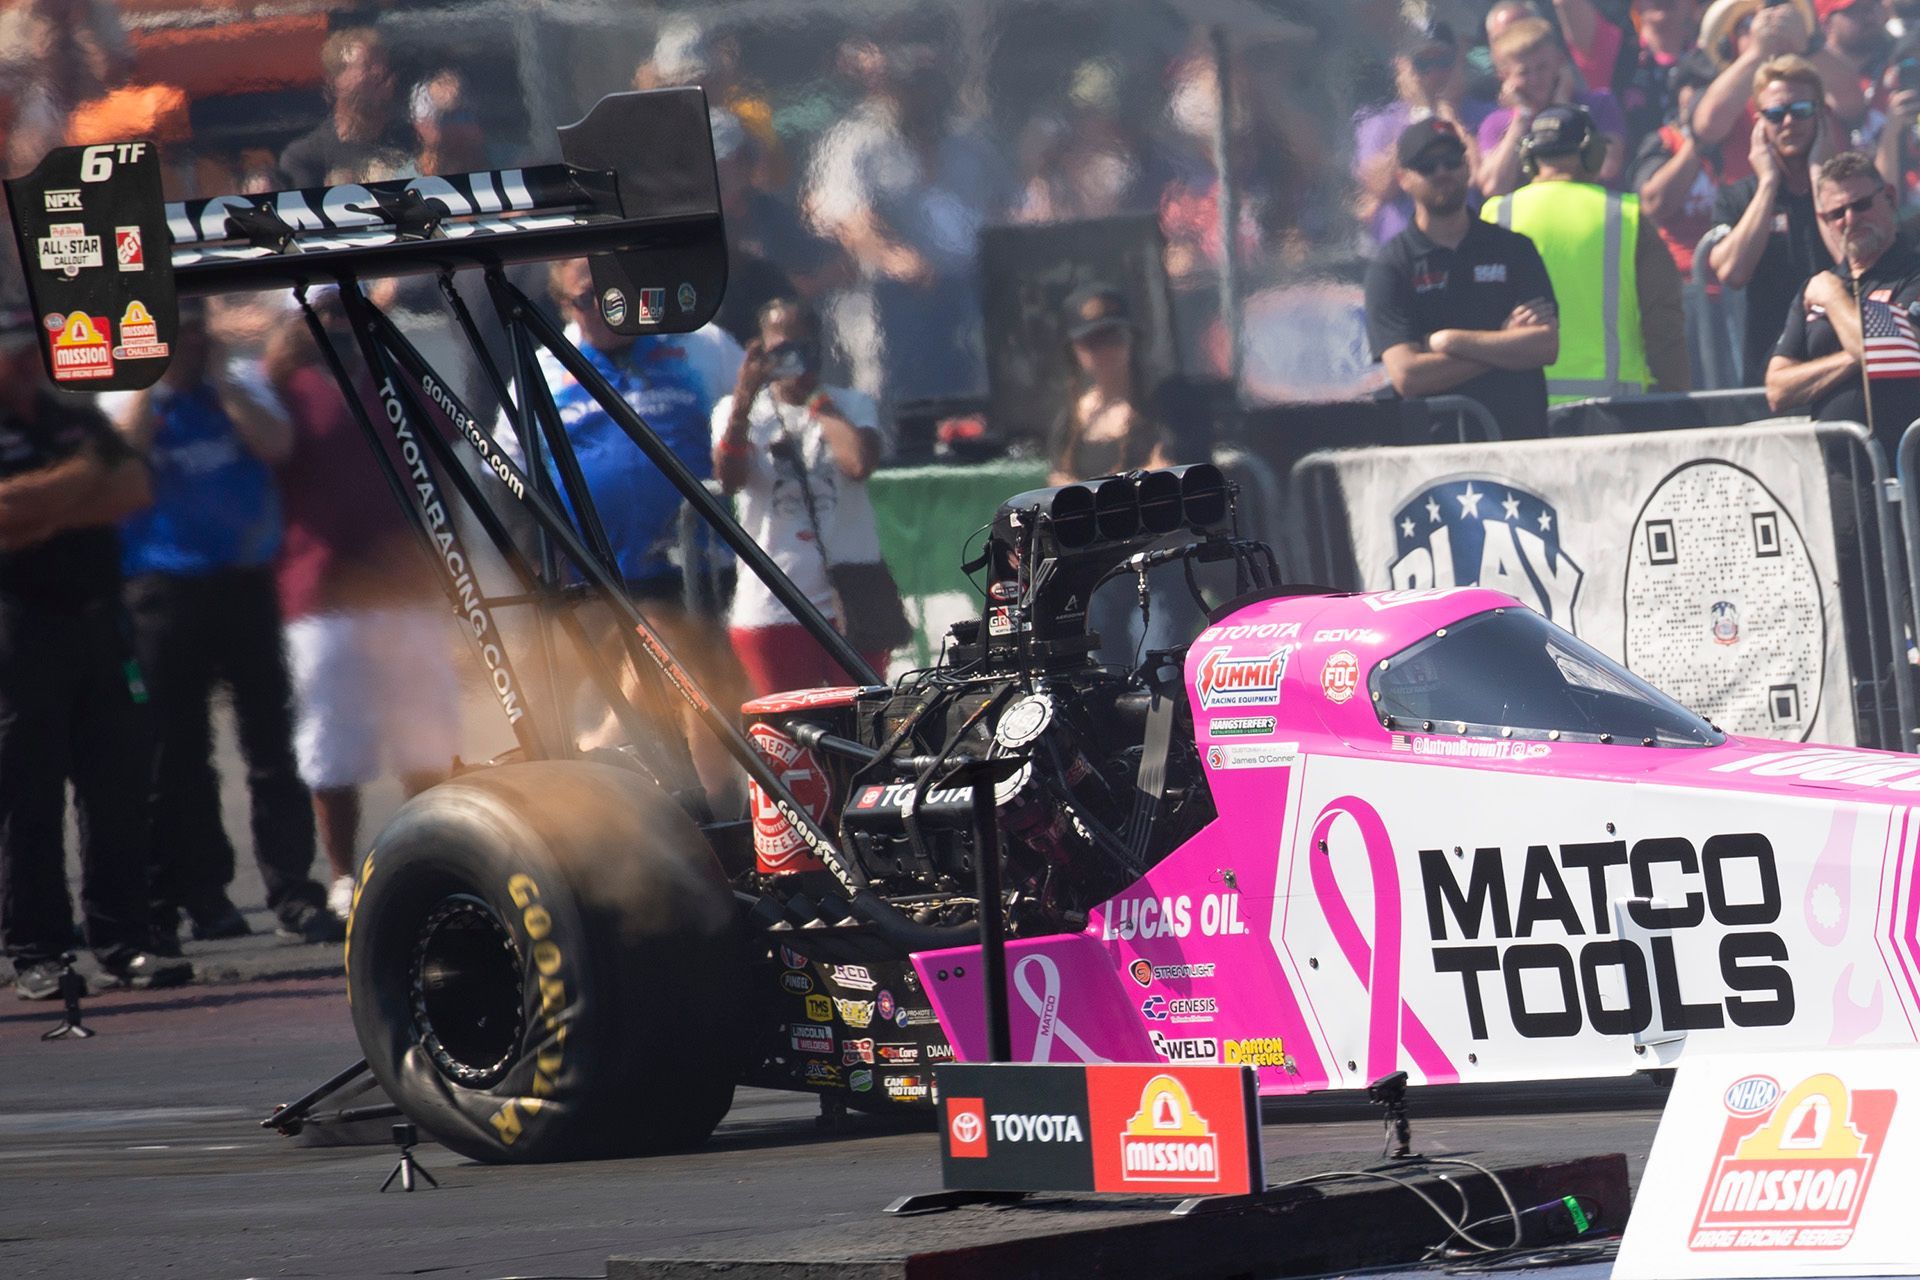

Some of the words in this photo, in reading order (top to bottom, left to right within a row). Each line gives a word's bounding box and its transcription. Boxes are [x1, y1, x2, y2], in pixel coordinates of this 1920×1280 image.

[45, 193, 82, 208] NPK
[54, 256, 88, 265] CALLOUT
[57, 346, 107, 365] MISSION
[126, 346, 166, 357] CHALLENGE
[421, 373, 524, 500] gomatco.com
[379, 377, 524, 725] TOYOTARACING.COM
[1219, 623, 1302, 640] TOYOTA
[1325, 667, 1356, 686] FDC
[1238, 695, 1278, 703] EQUIPMENT
[1258, 755, 1295, 763] O'Conner
[1418, 832, 1782, 941] MATCO
[1103, 894, 1192, 941] LUCAS
[836, 965, 869, 979] RCD
[1154, 964, 1215, 978] STREAMLIGHT
[1432, 931, 1796, 1040] TOOLS
[1041, 995, 1056, 1036] MATCO
[1170, 999, 1215, 1013] GENESIS
[792, 1027, 825, 1039] LINCOLN
[1167, 1040, 1216, 1059] WELD
[888, 1086, 927, 1096] MOTION
[1728, 1079, 1776, 1110] NHRA
[991, 1114, 1084, 1142] TOYOTA
[1126, 1142, 1214, 1171] MISSION
[1712, 1168, 1858, 1212] MISSION
[1734, 1229, 1795, 1247] RACING
[1794, 1228, 1853, 1246] SERIES
